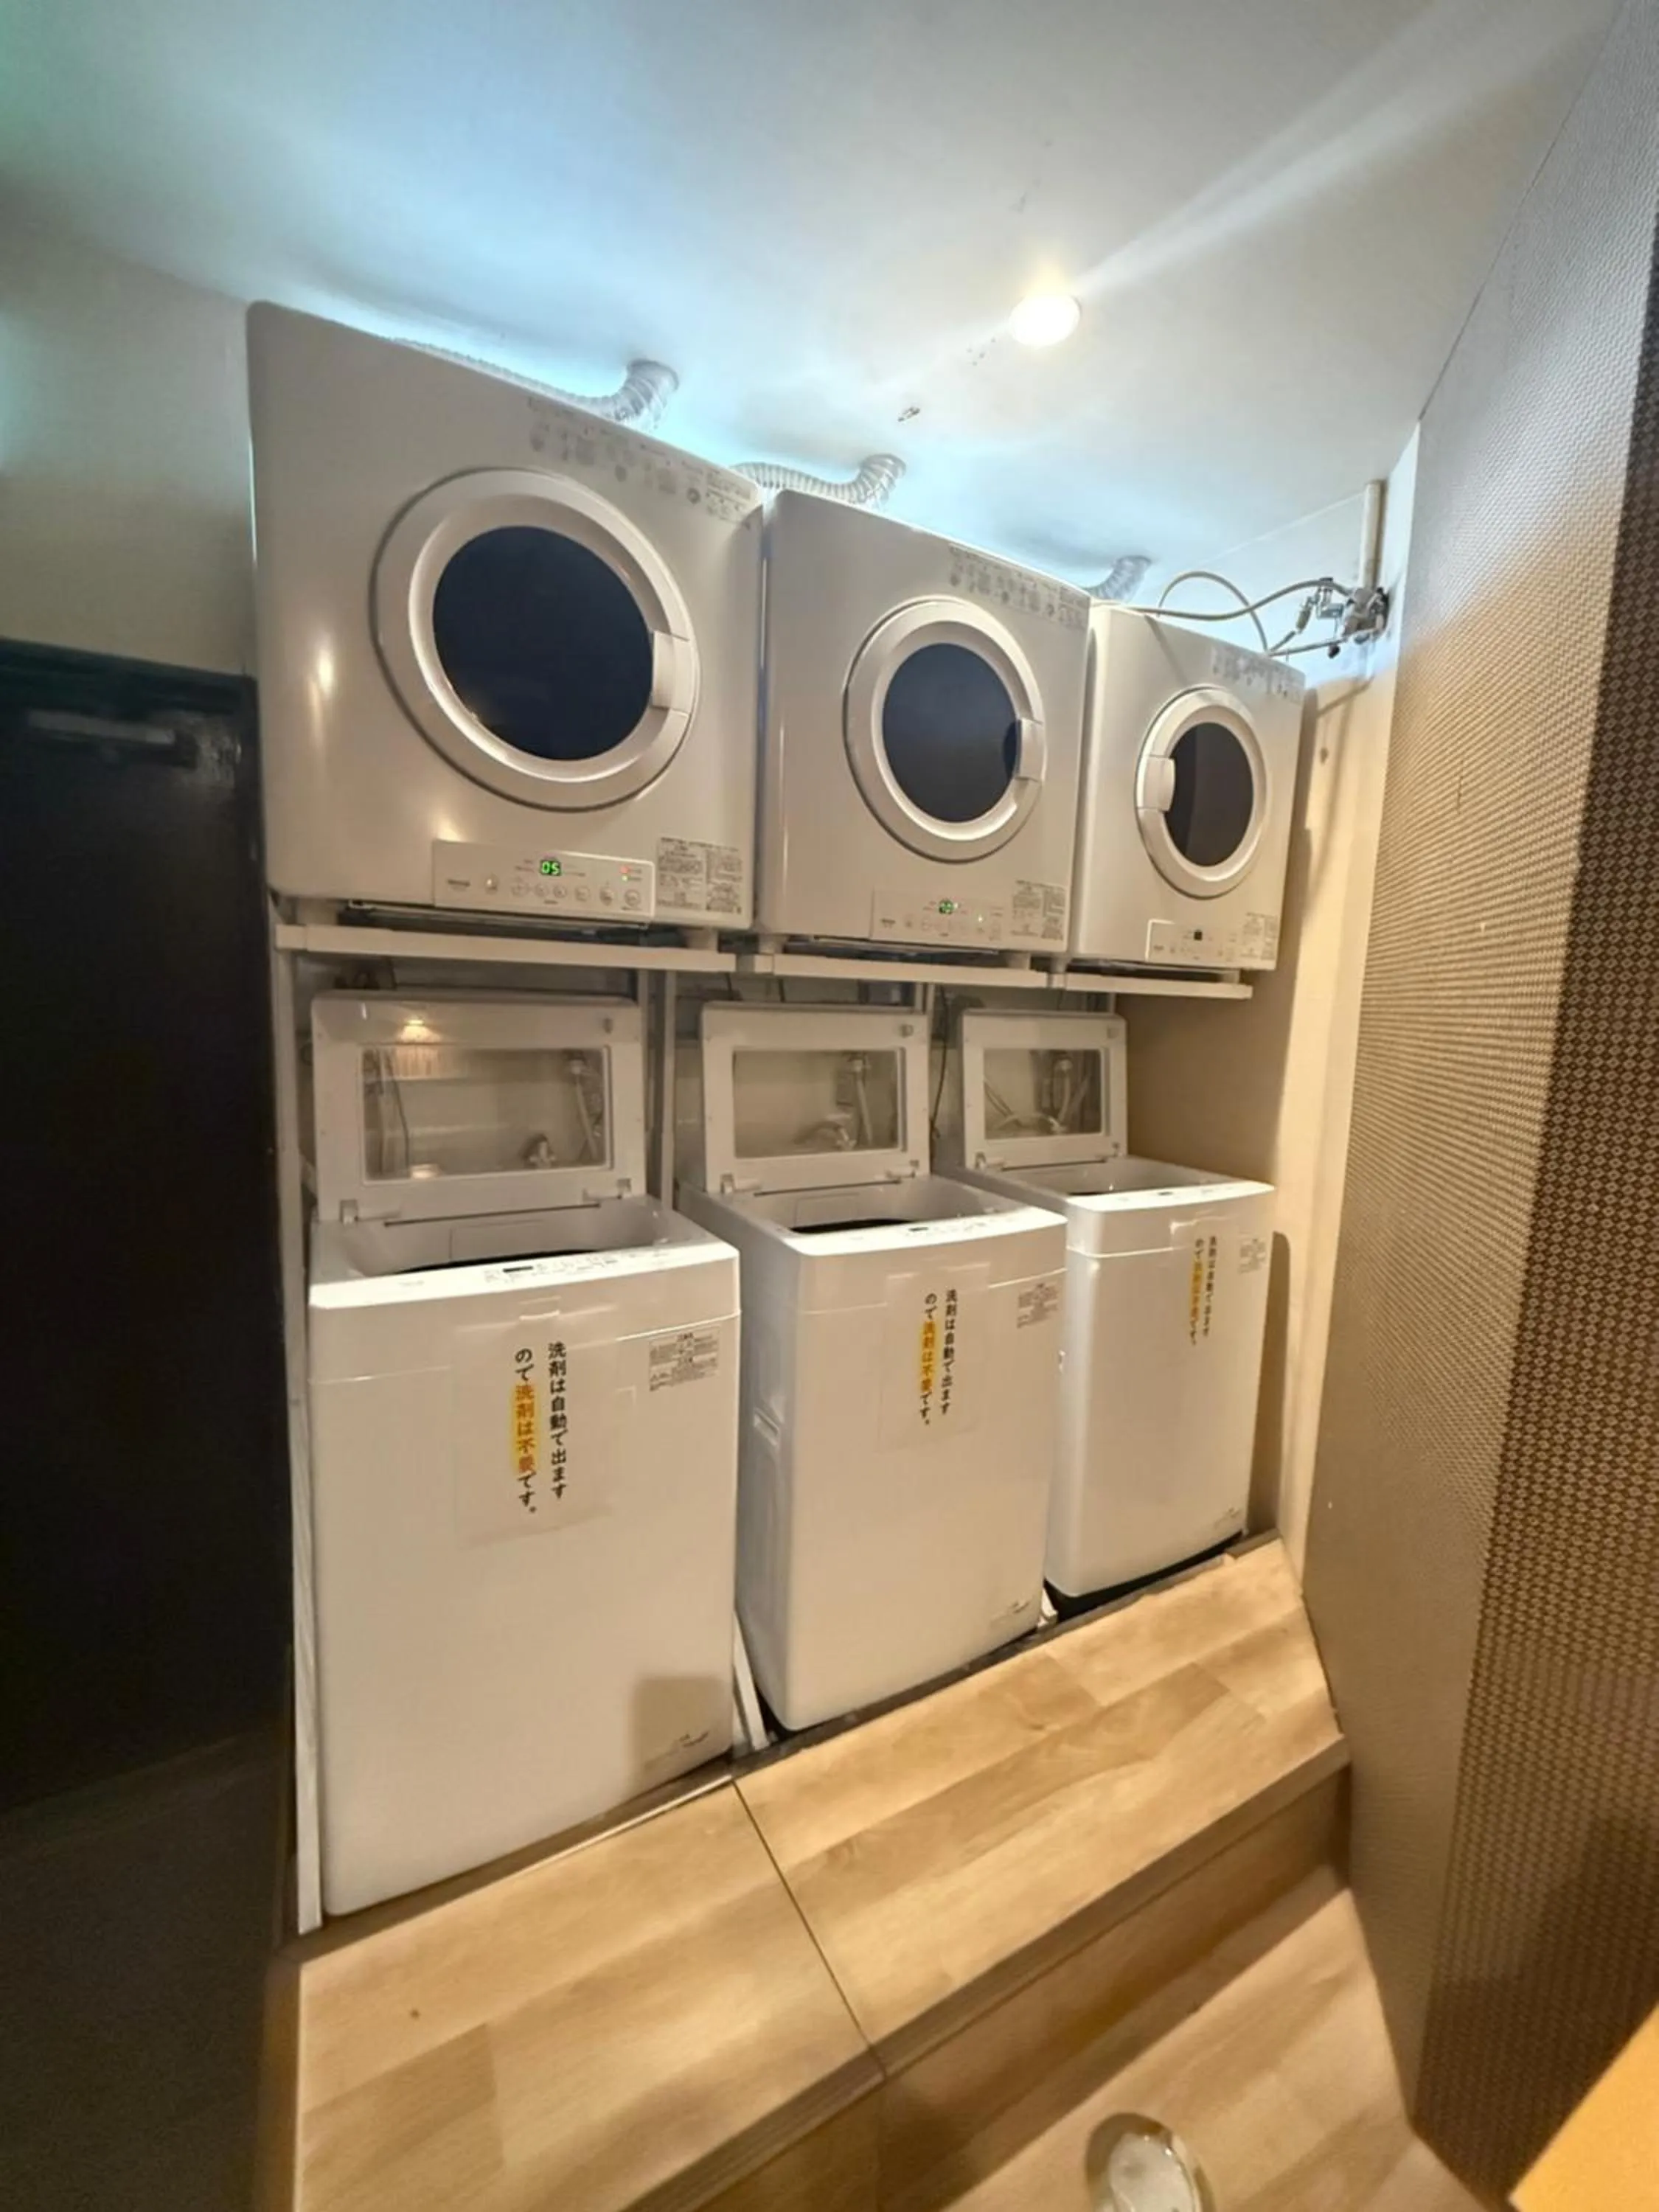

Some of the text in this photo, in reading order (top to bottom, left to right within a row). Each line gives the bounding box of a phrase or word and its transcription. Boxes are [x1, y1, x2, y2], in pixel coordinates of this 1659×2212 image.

[548, 1341, 568, 1499] 洗剤は自動で出ます
